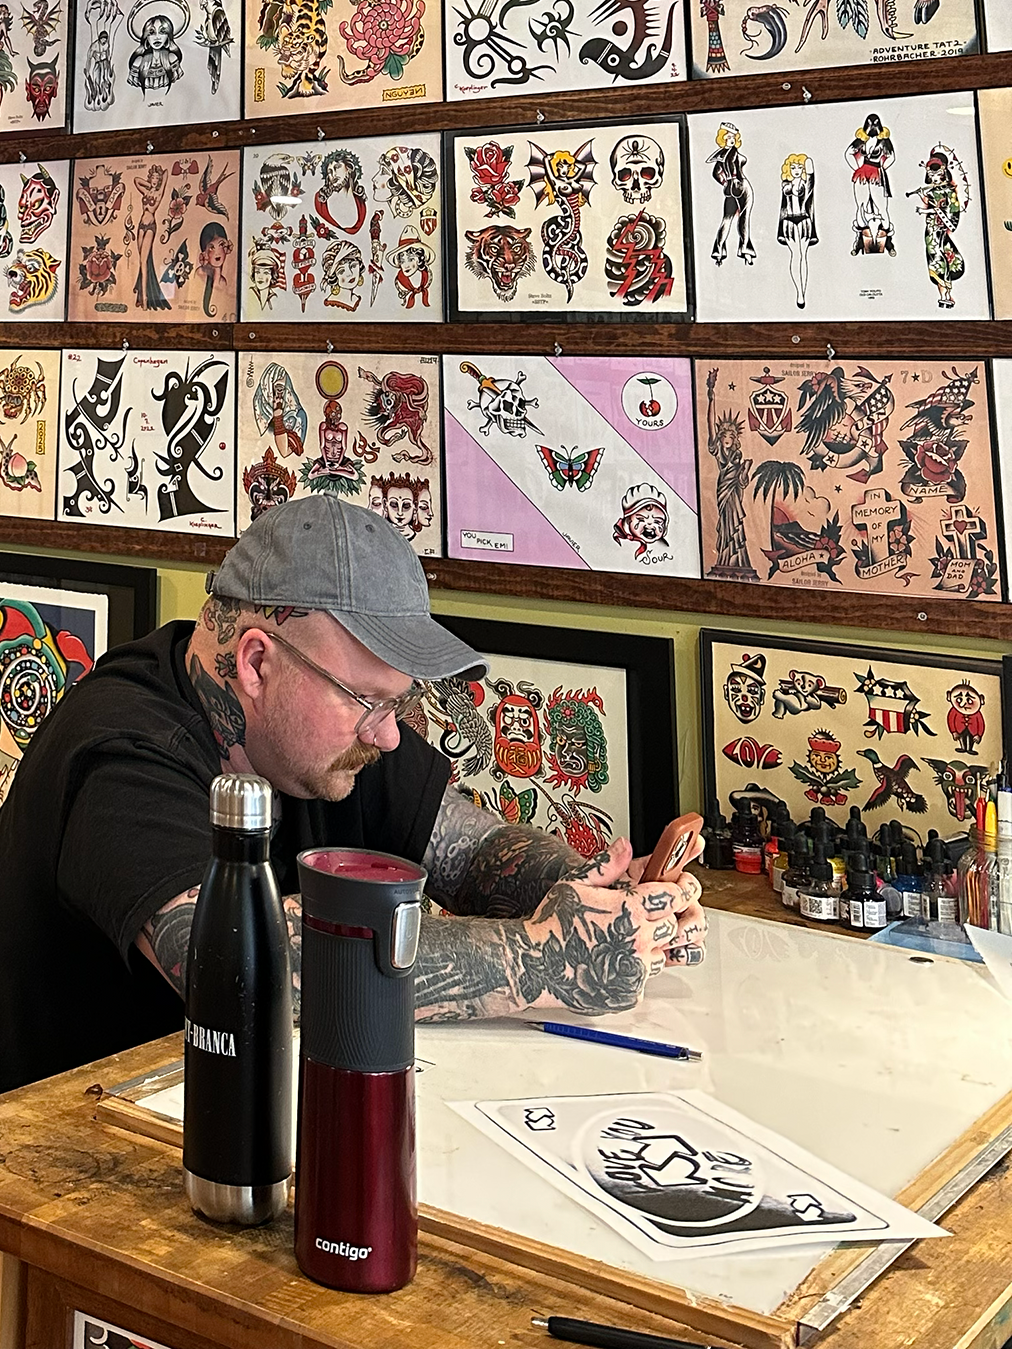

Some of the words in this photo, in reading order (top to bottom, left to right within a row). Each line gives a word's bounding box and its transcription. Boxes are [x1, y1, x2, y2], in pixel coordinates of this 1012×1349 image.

[873, 43, 930, 54] ADVENTURE
[873, 51, 937, 63] ROHRBACHER
[940, 48, 964, 57] 2019
[635, 419, 664, 428] YOURS
[909, 485, 949, 495] NAME
[855, 505, 898, 517] MEMORY
[872, 522, 882, 530] OF
[872, 534, 885, 544] MY
[782, 553, 816, 569] ALOHA
[861, 556, 905, 577] MOTHER
[791, 578, 811, 586] SAILOR
[812, 579, 829, 587] JERRY
[315, 1237, 369, 1261] contigo
